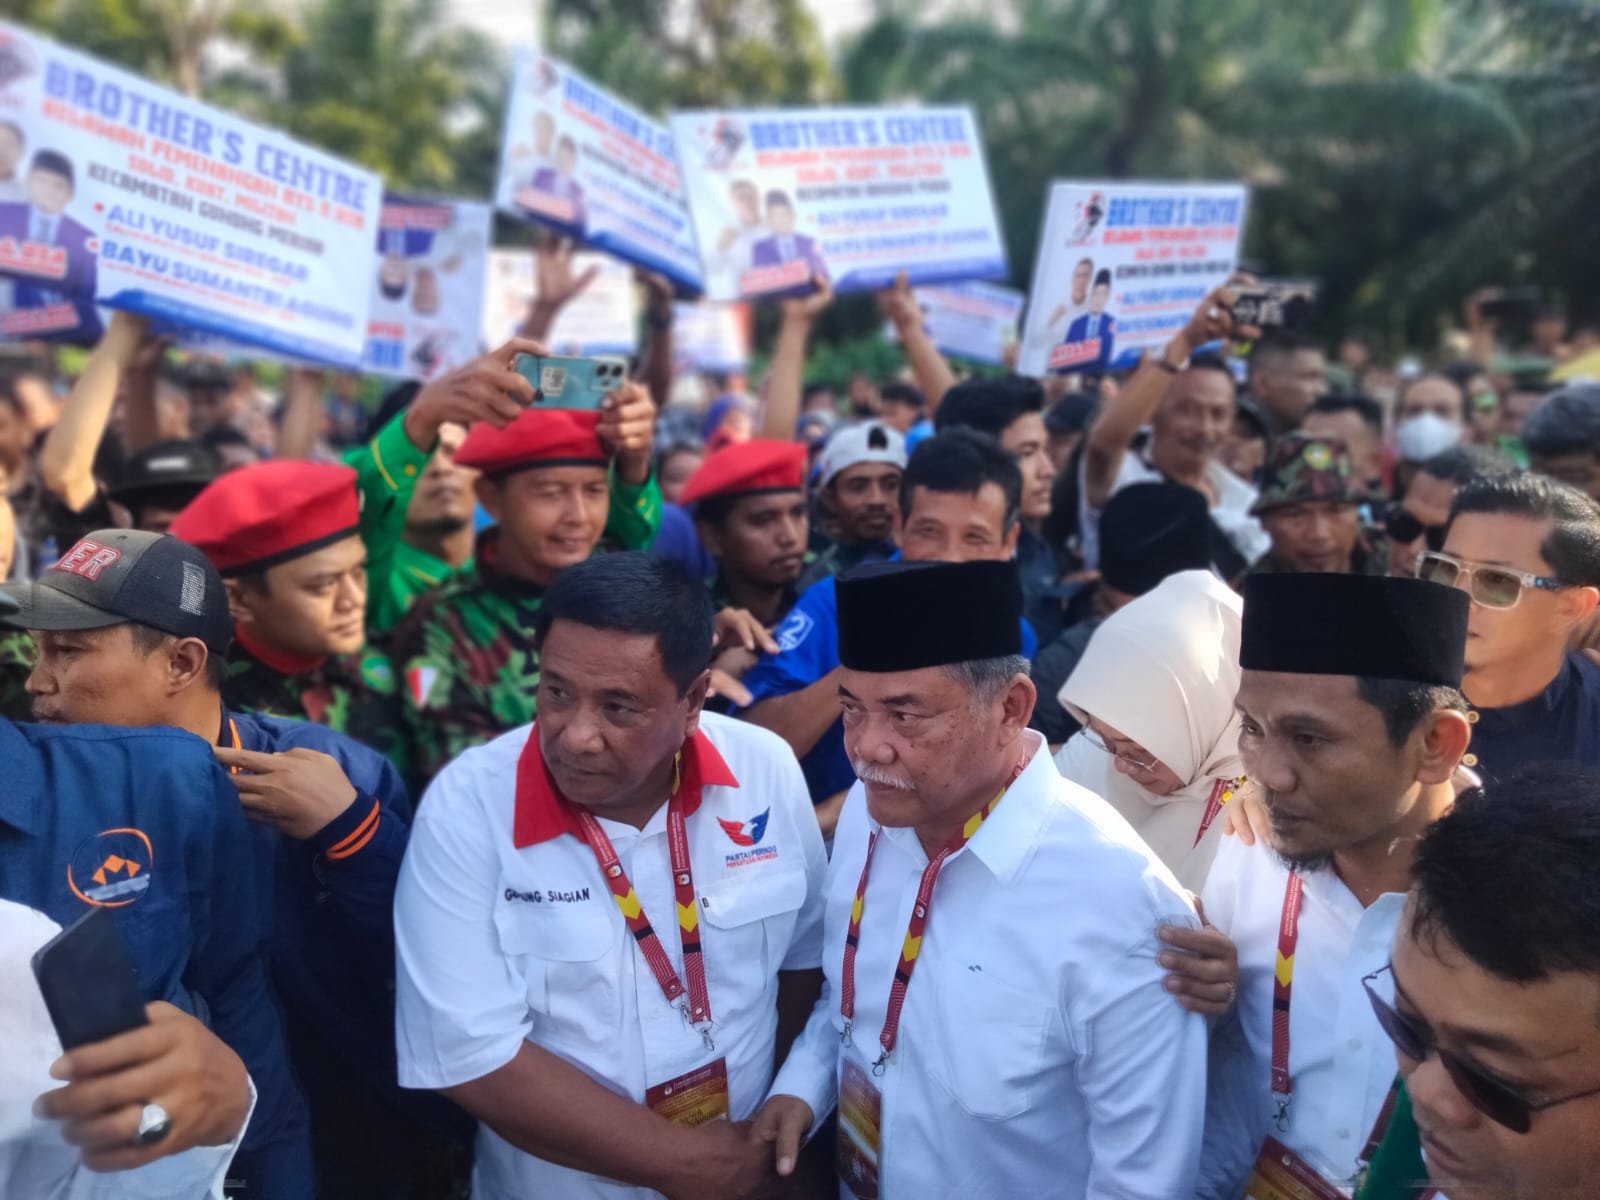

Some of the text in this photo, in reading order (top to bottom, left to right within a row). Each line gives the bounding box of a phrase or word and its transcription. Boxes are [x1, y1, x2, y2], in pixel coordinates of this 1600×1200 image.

[43, 55, 366, 211] BROTHER'S CENTRE
[107, 202, 144, 230] ALI
[149, 216, 219, 253] YUSUF
[101, 239, 168, 272] BAYU
